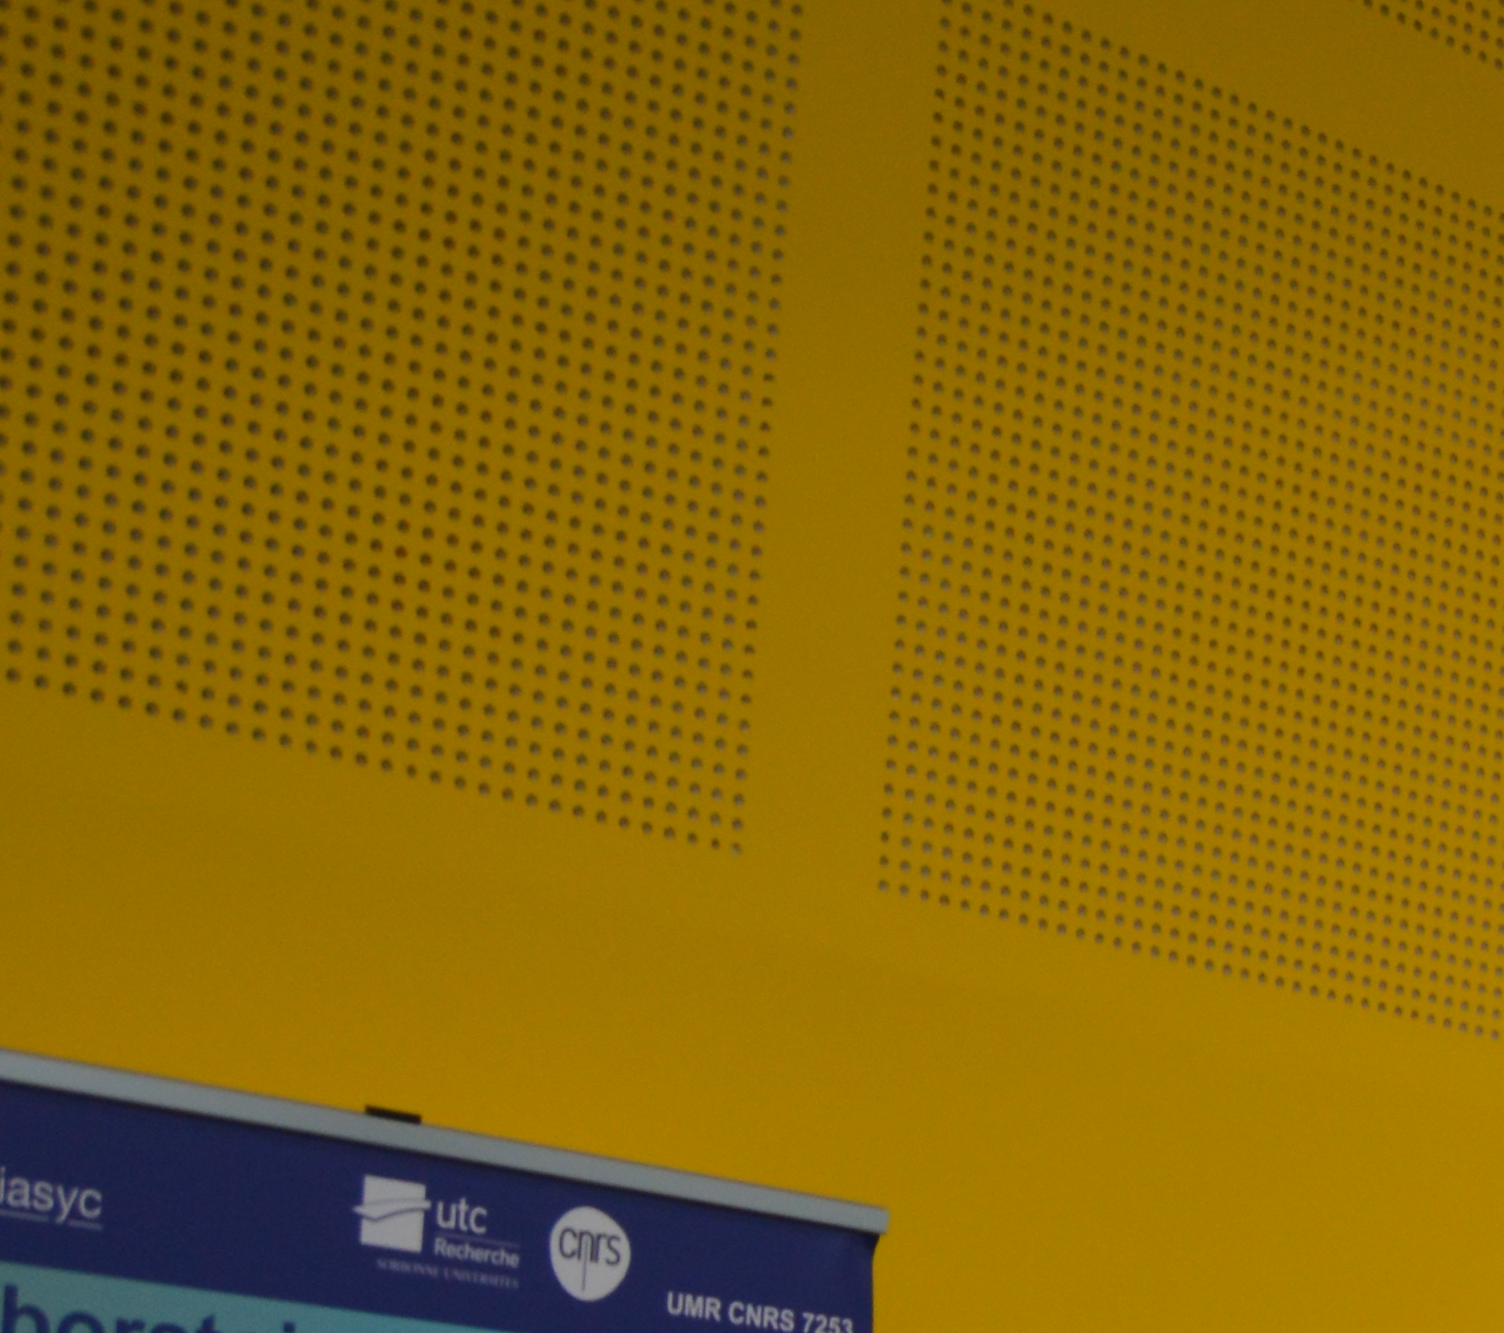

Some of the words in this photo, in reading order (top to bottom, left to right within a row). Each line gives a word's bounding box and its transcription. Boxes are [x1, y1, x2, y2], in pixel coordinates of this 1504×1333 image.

[436, 1197, 489, 1234] utc
[433, 1236, 520, 1269] Recherche
[559, 1227, 621, 1272] cnrs
[667, 1291, 722, 1322] UMR
[728, 1301, 795, 1333] CNRS
